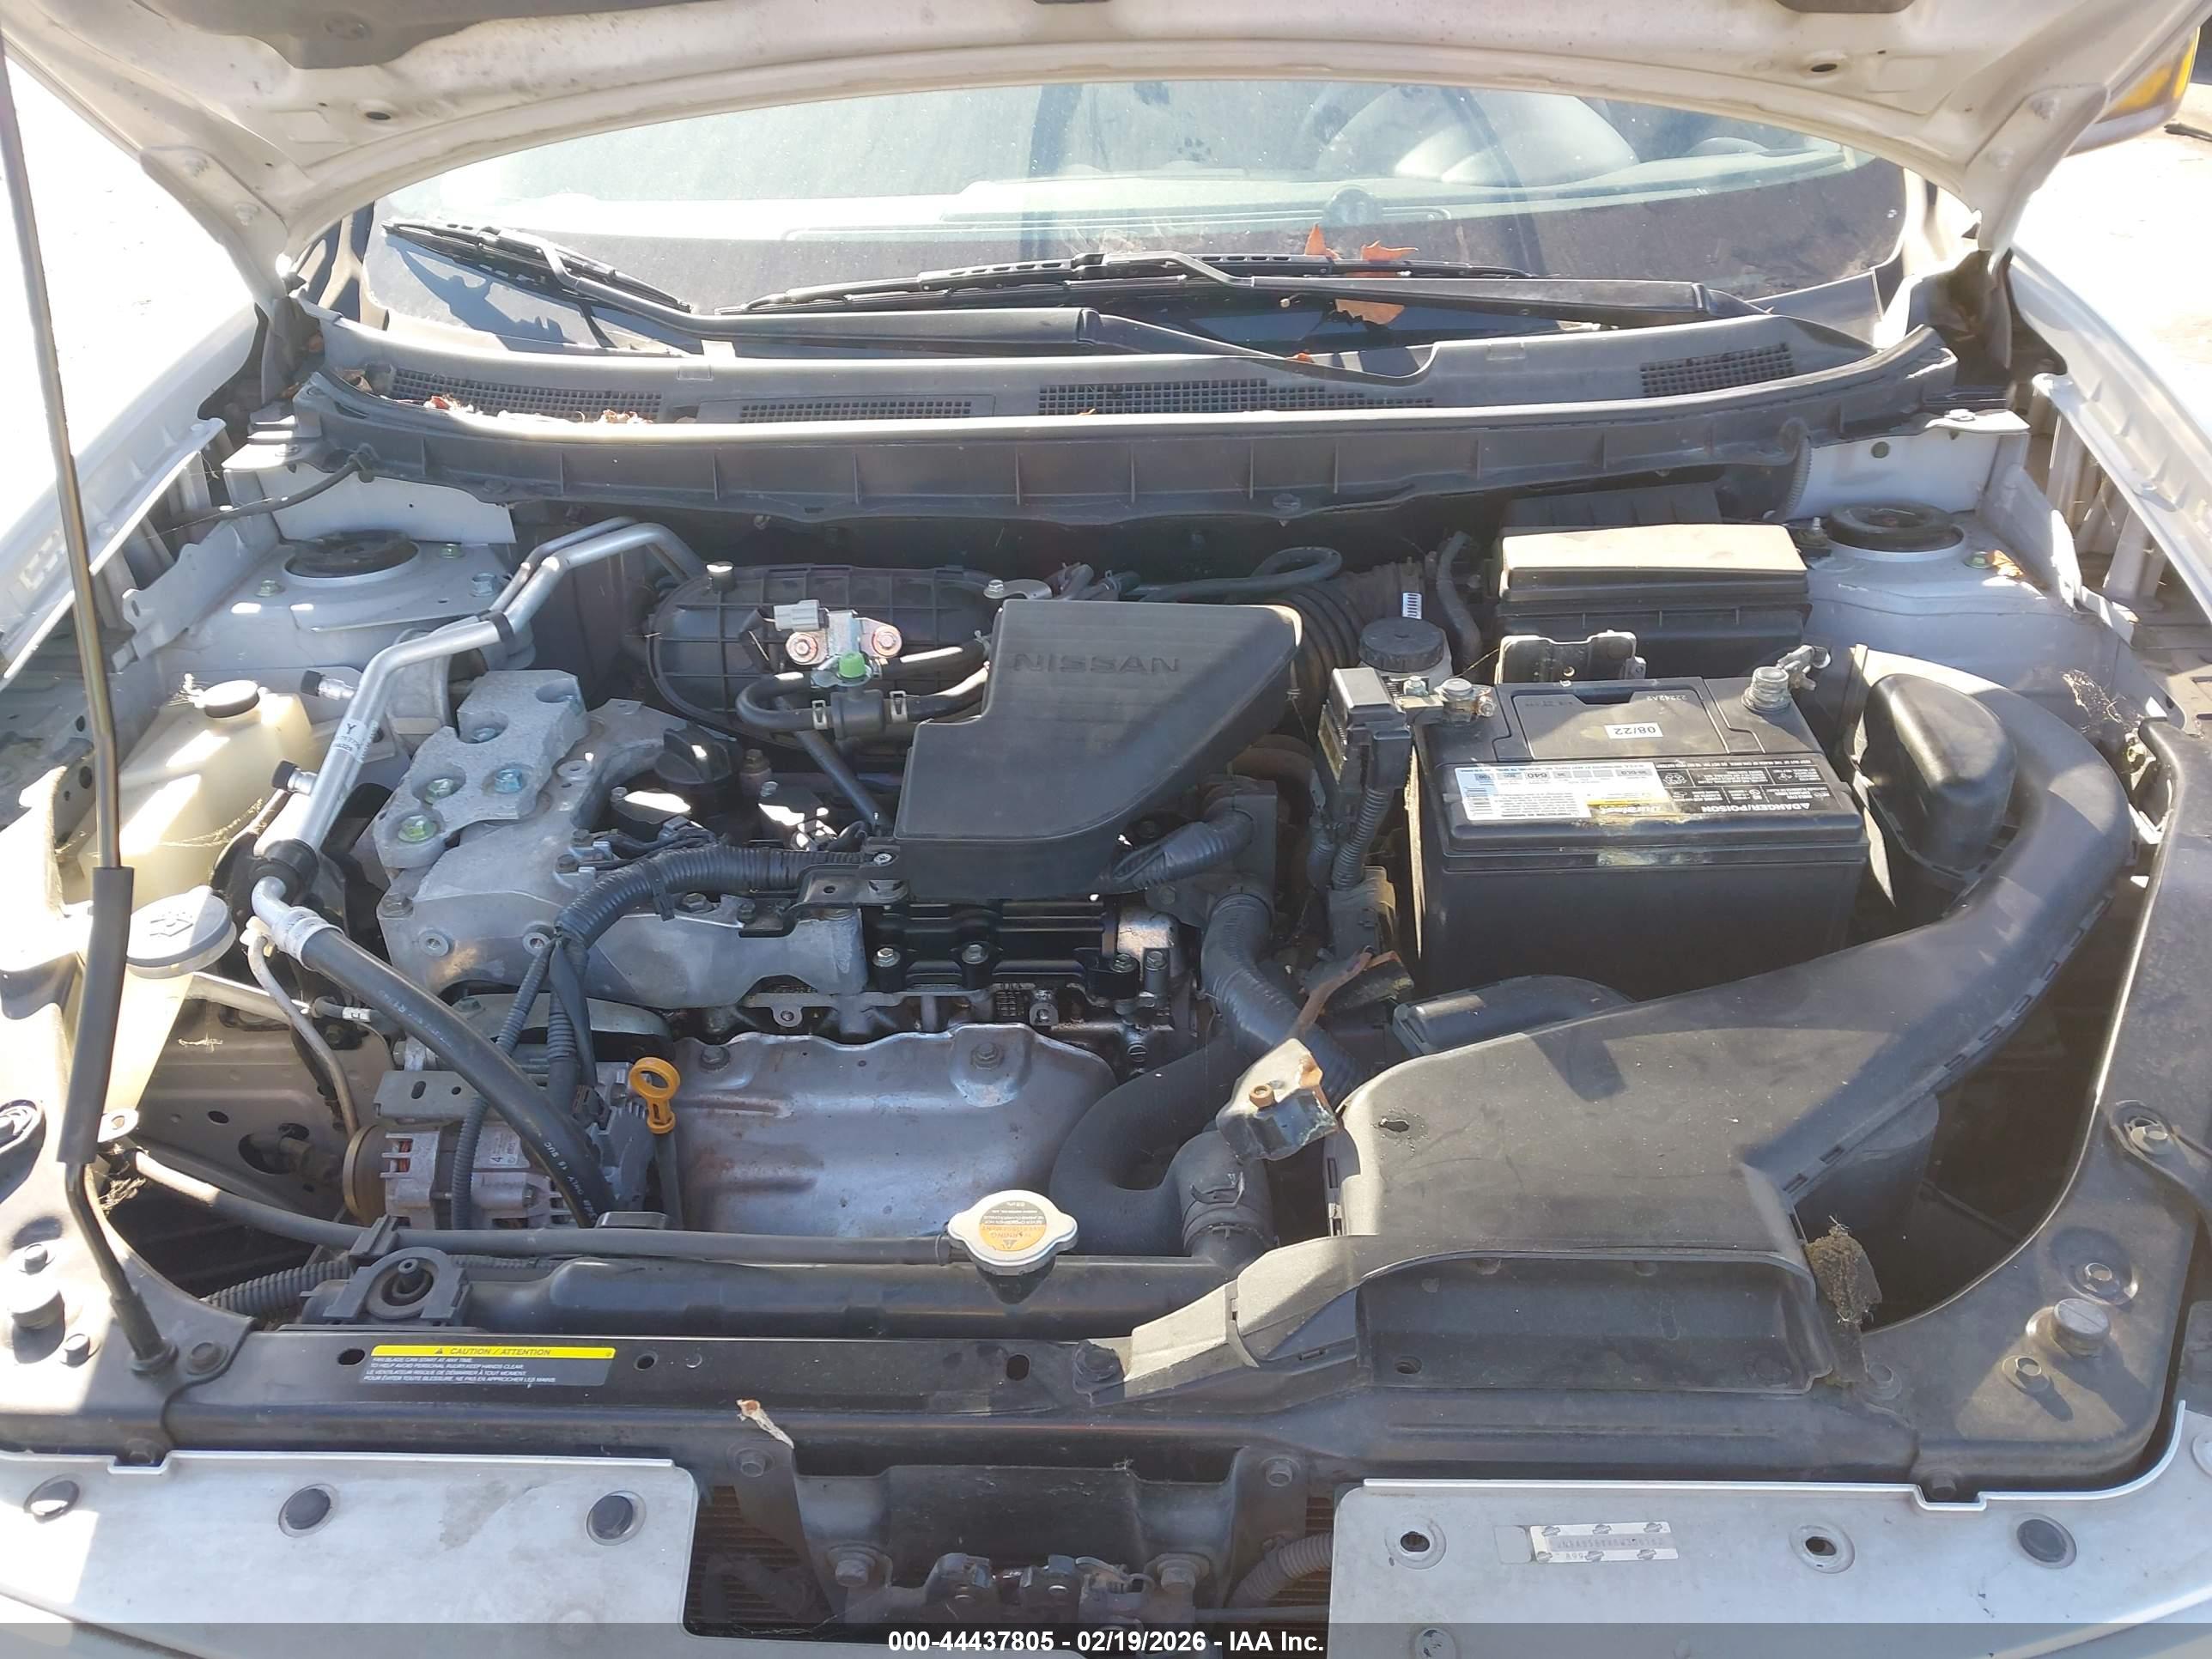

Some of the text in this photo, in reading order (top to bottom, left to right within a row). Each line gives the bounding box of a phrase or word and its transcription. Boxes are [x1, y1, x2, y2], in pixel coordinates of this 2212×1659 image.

[1013, 653, 1181, 673] NISSAN
[346, 722, 357, 735] Y
[1613, 726, 1656, 736] 08/22
